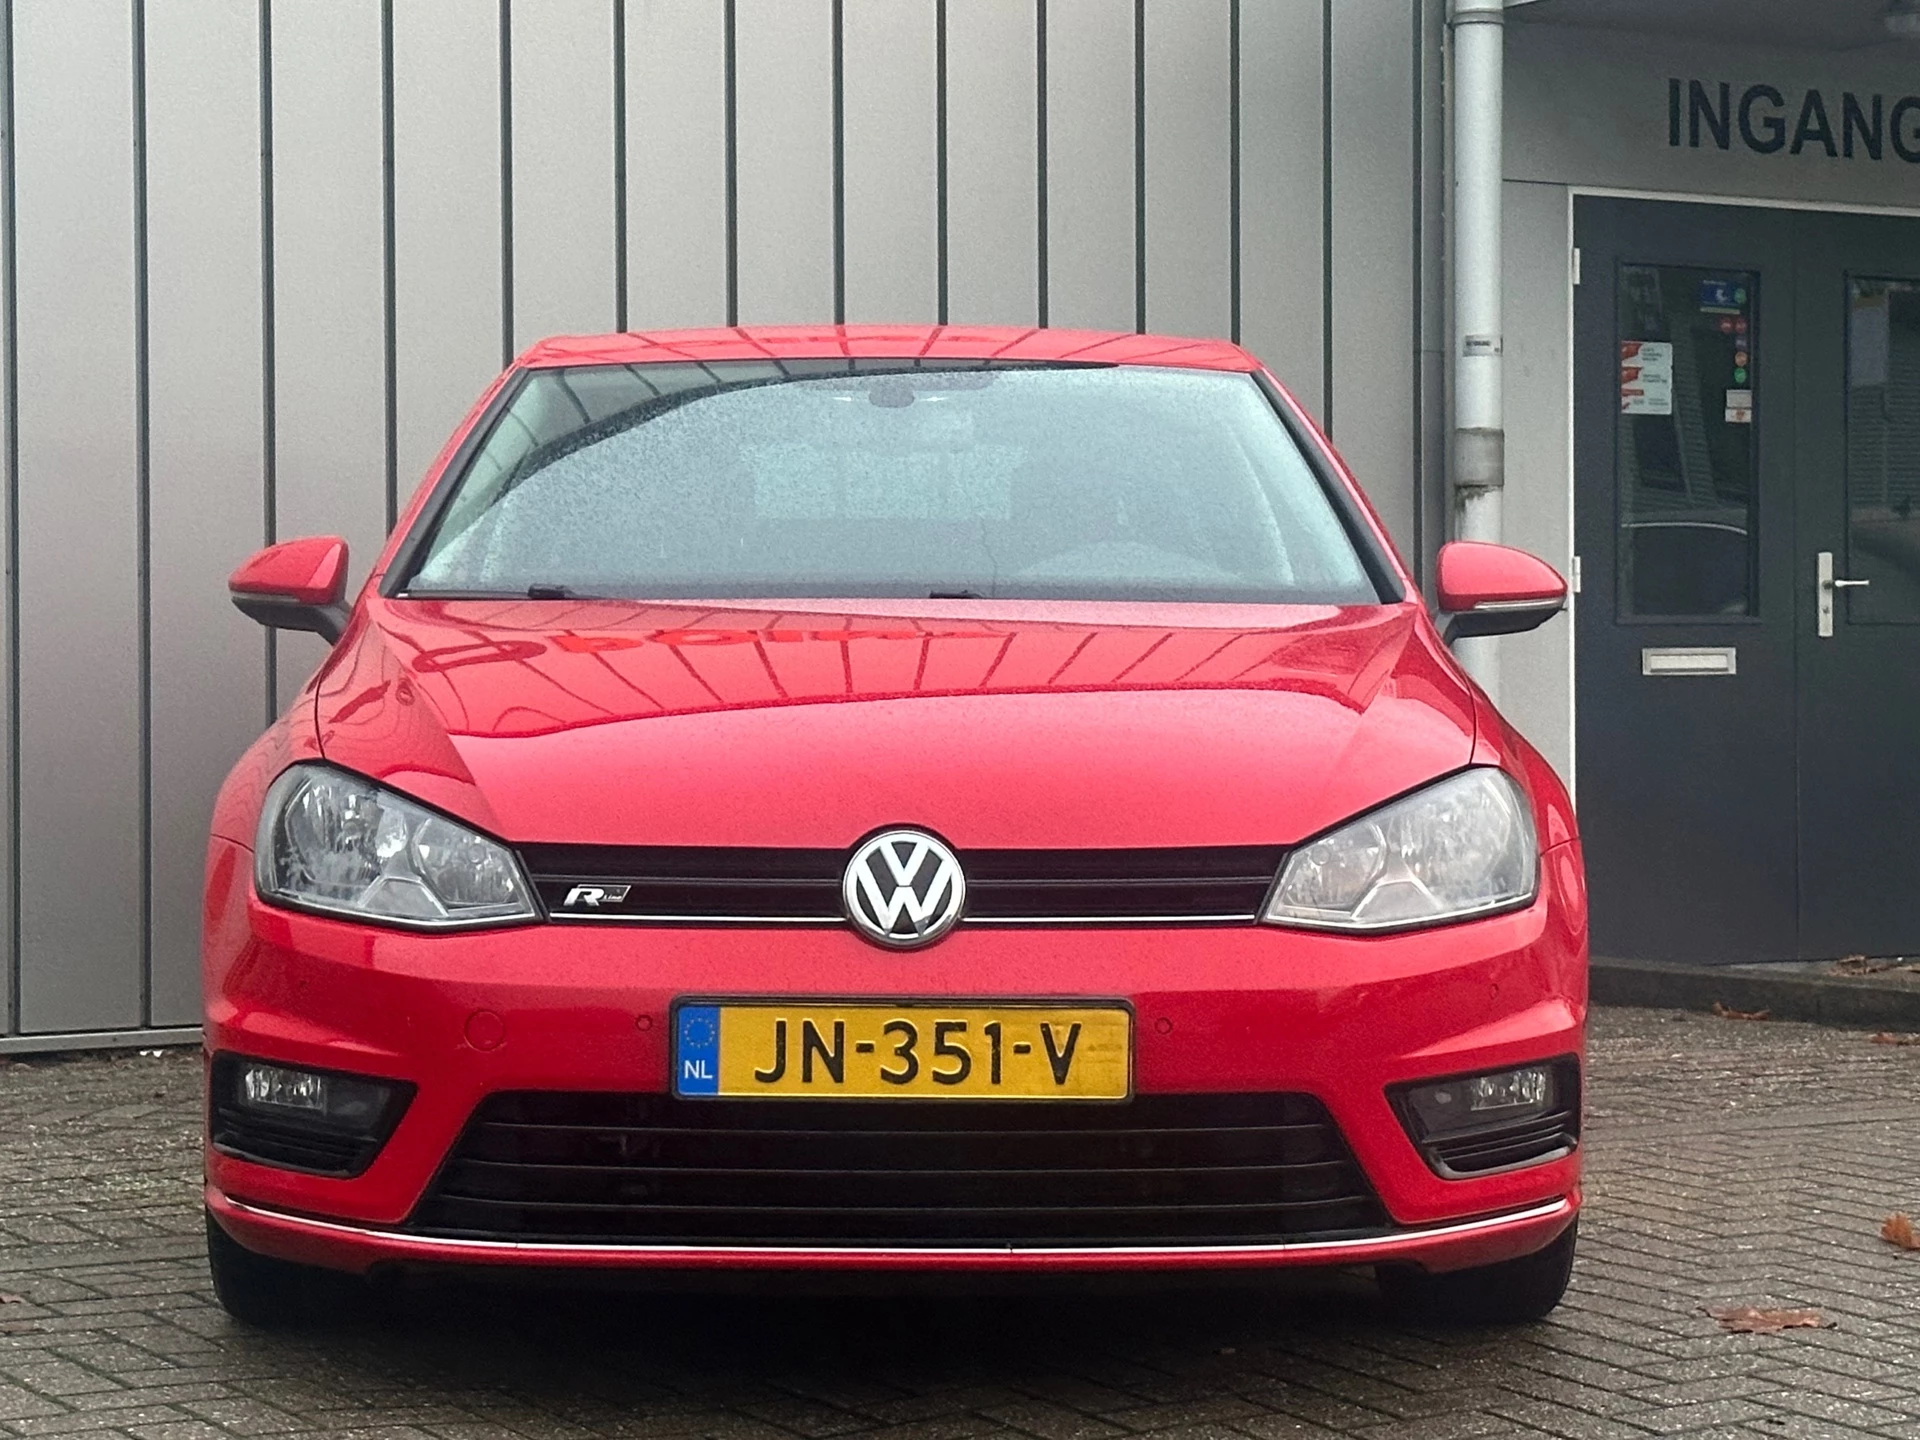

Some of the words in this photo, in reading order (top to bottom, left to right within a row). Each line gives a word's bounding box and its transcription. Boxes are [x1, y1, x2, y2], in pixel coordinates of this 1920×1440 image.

[1668, 77, 1920, 163] INGANG
[852, 836, 956, 937] VW
[684, 1059, 713, 1079] NL
[754, 1018, 1082, 1085] JN-351-V
